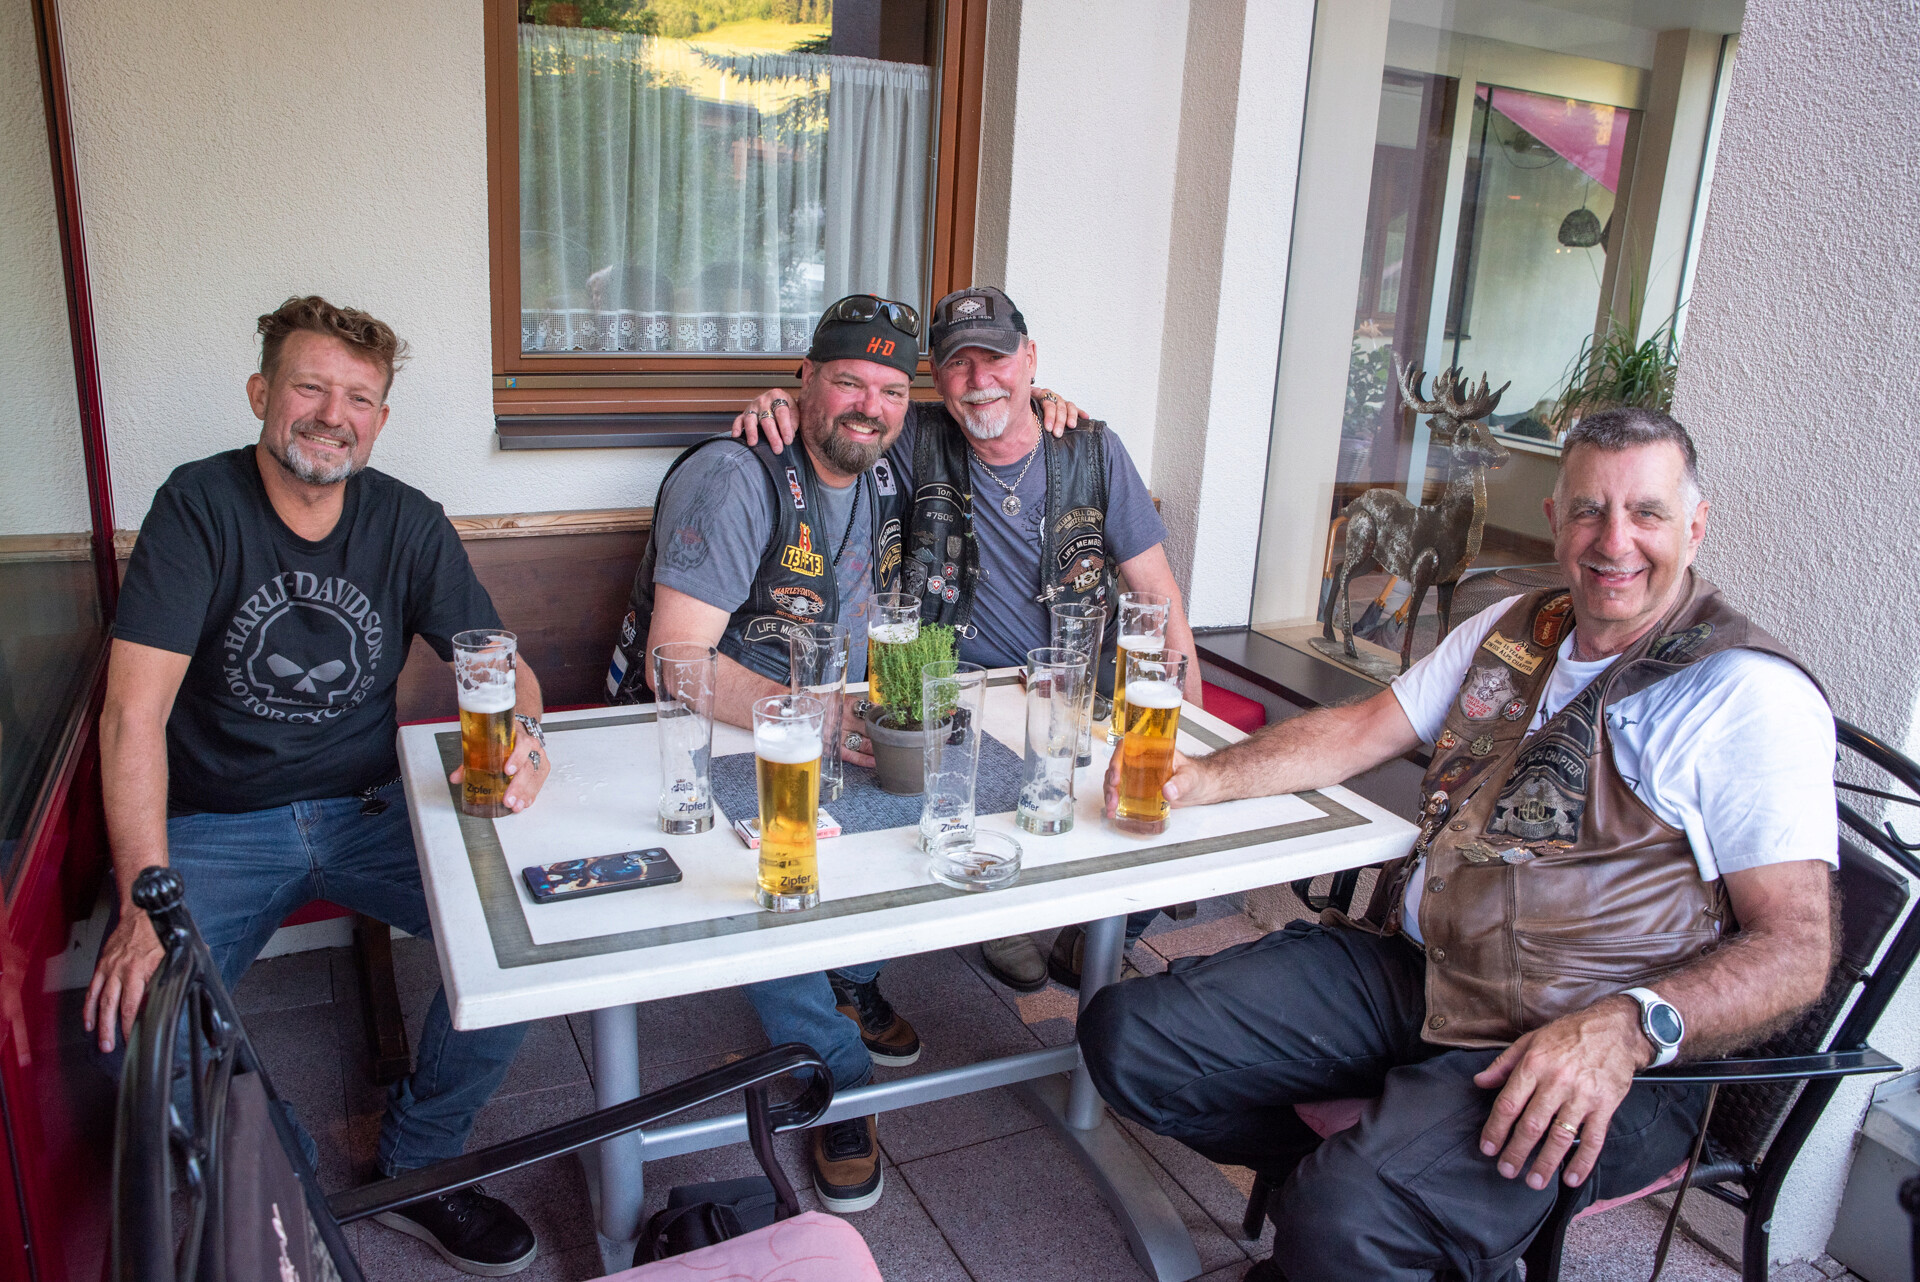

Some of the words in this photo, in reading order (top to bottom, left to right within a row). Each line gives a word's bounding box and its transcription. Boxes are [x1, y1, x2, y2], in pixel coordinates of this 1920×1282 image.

[866, 337, 896, 356] H-D
[1062, 545, 1076, 560] LIFE
[1076, 538, 1102, 549] MEMBE
[1074, 568, 1100, 589] HOG
[757, 623, 777, 633] LIFE
[1486, 640, 1499, 652] SWISS
[1499, 649, 1513, 661] ALPS
[1511, 659, 1533, 672] CHAPTER
[1509, 648, 1524, 661] YEARS
[1545, 750, 1583, 777] CHAPTER
[467, 782, 491, 796] Zipfer
[679, 801, 706, 814] Zipfer
[780, 874, 811, 888] Zipfer
